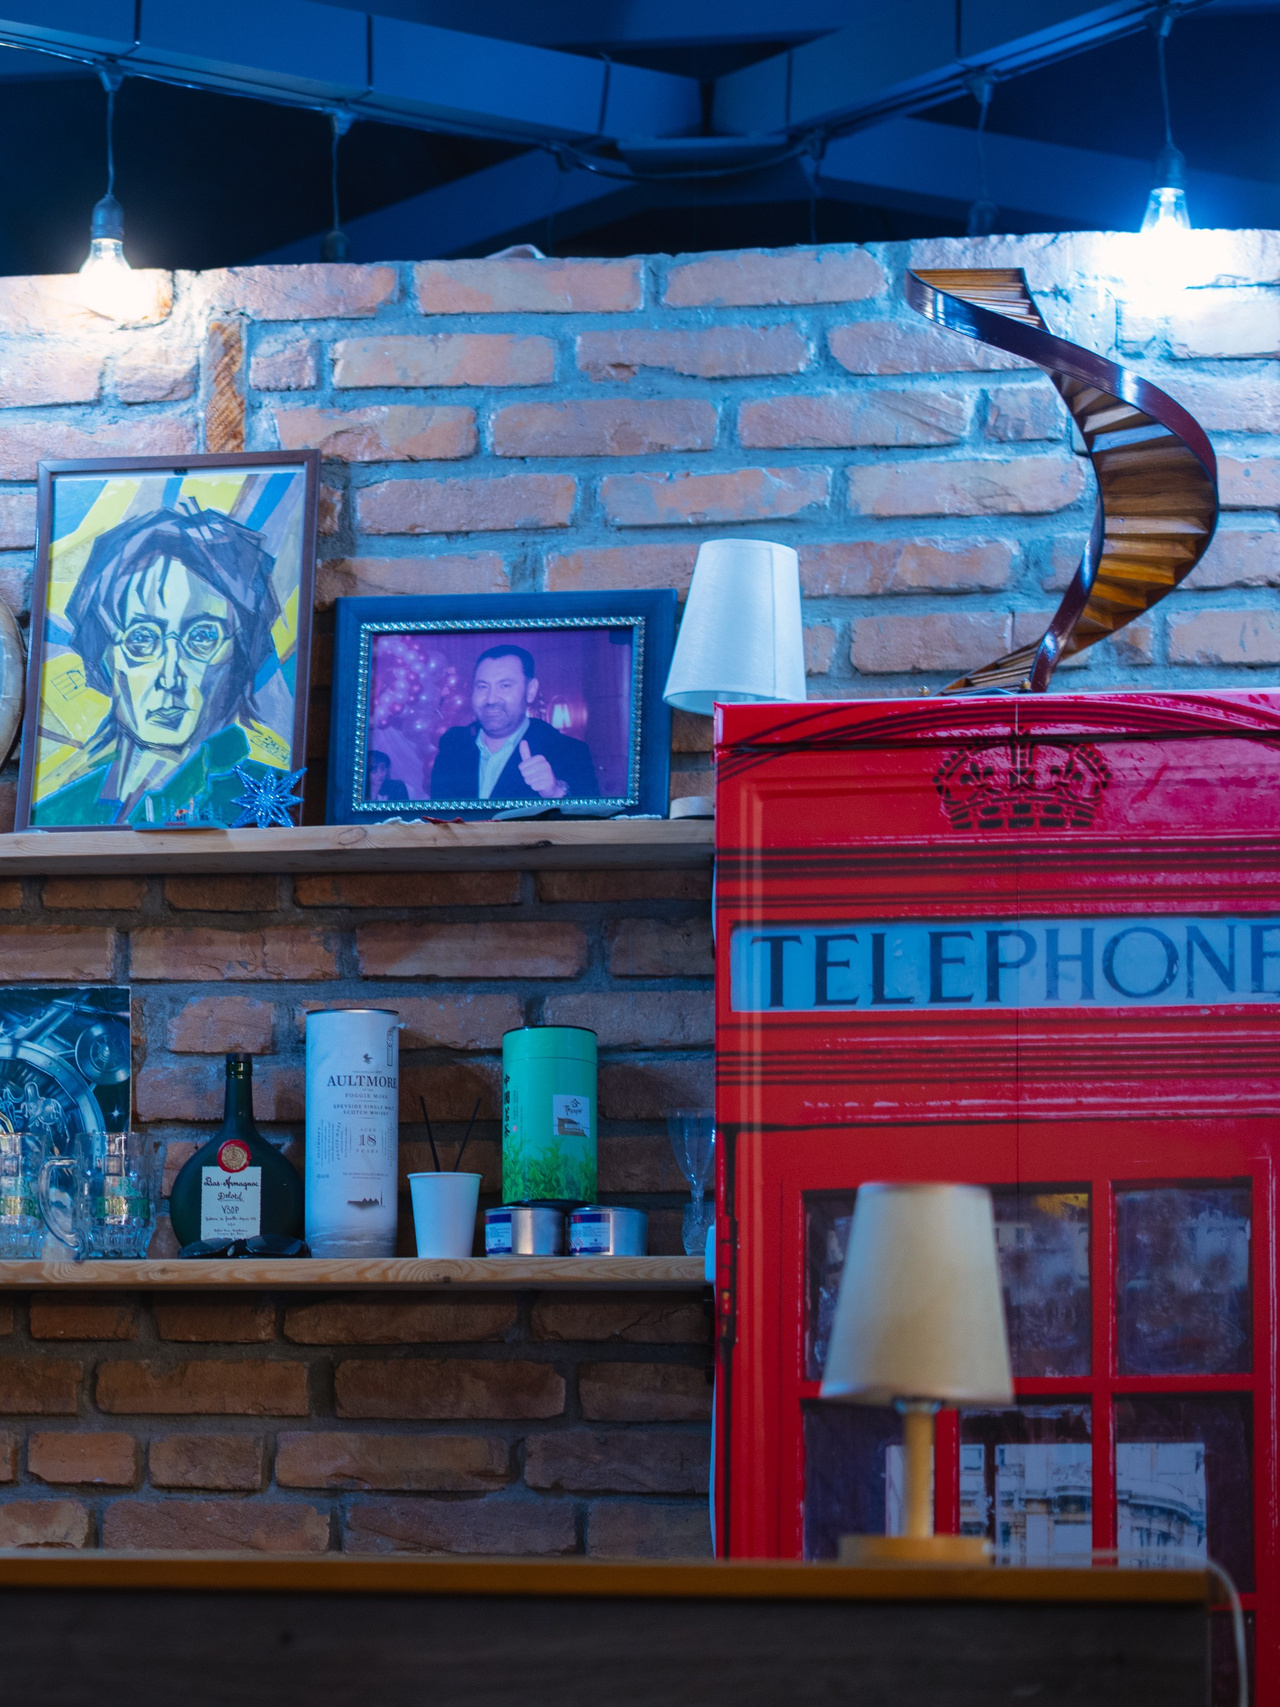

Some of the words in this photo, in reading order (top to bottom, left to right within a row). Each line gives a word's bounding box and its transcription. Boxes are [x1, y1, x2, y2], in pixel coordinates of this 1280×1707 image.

[749, 924, 1280, 1008] TELEPHONE
[327, 1074, 397, 1089] AULTMORE
[359, 1134, 377, 1147] 18
